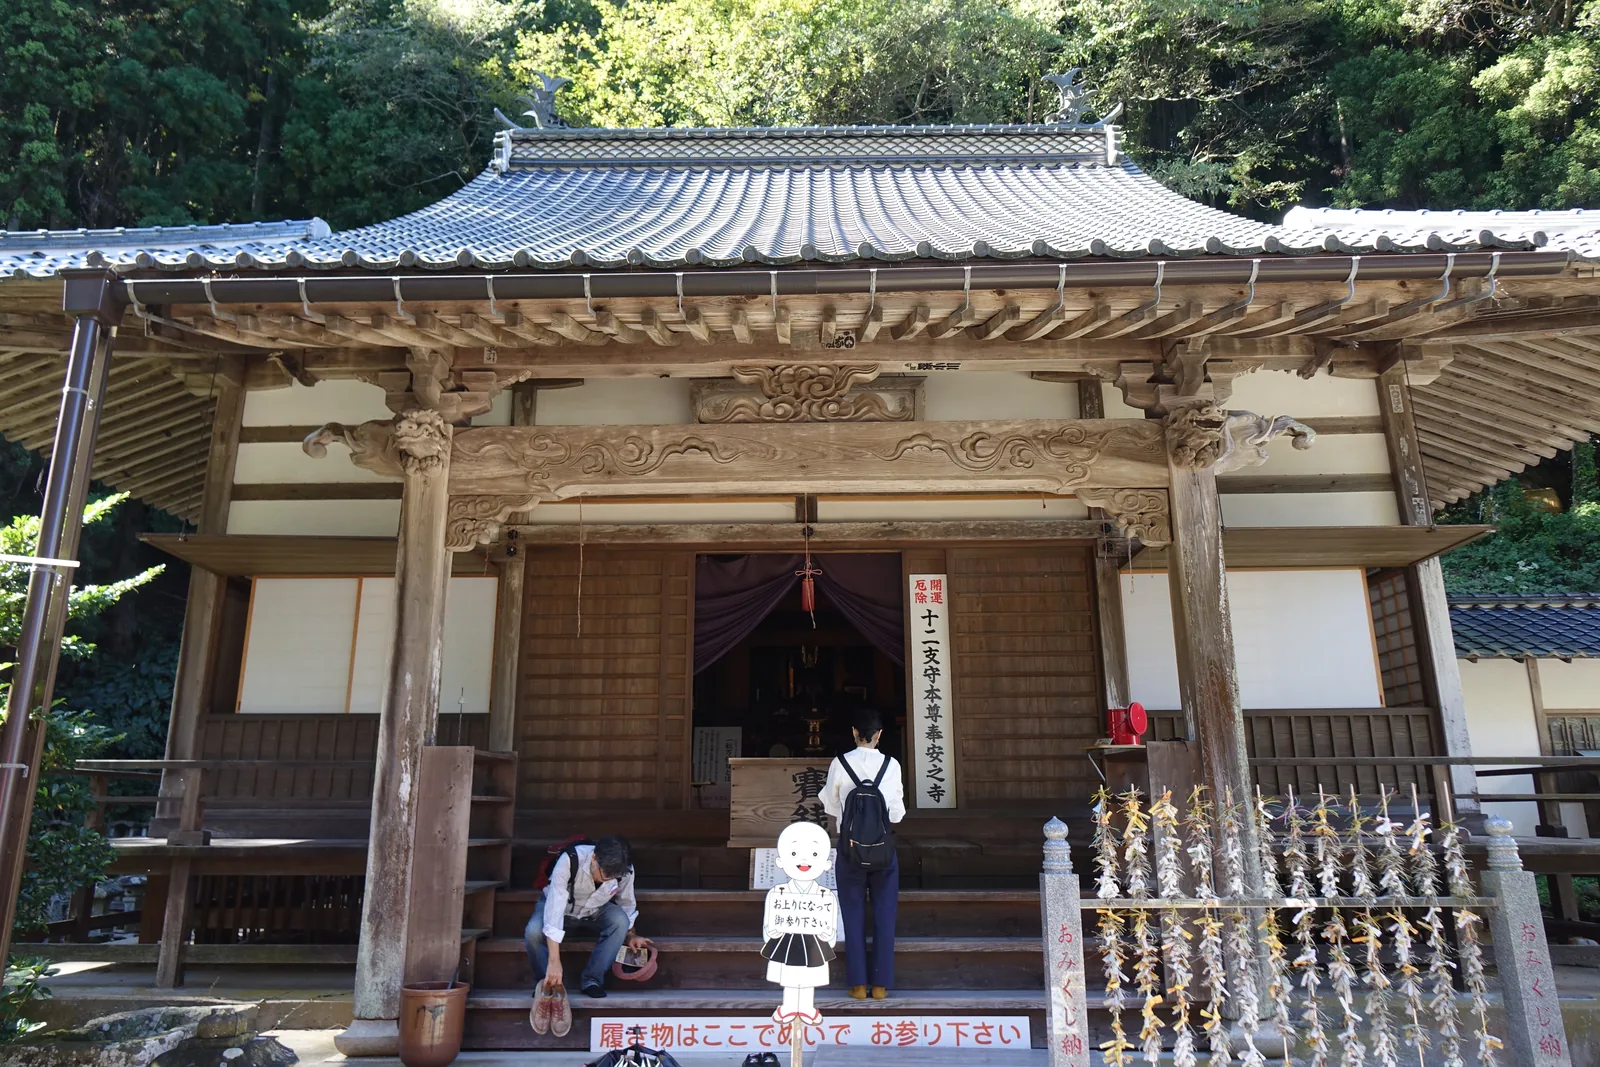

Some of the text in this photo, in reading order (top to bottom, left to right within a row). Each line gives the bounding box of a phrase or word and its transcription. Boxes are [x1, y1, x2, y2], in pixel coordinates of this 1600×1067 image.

[914, 579, 928, 604] 厄除
[930, 579, 943, 605] 開運
[920, 608, 946, 804] 十二支守本尊奉安之寺
[773, 898, 832, 912] お上りになって
[1057, 923, 1083, 1067] おみくじ納
[1521, 921, 1562, 1067] おみくじ納
[870, 1021, 1021, 1046] お参り下さい
